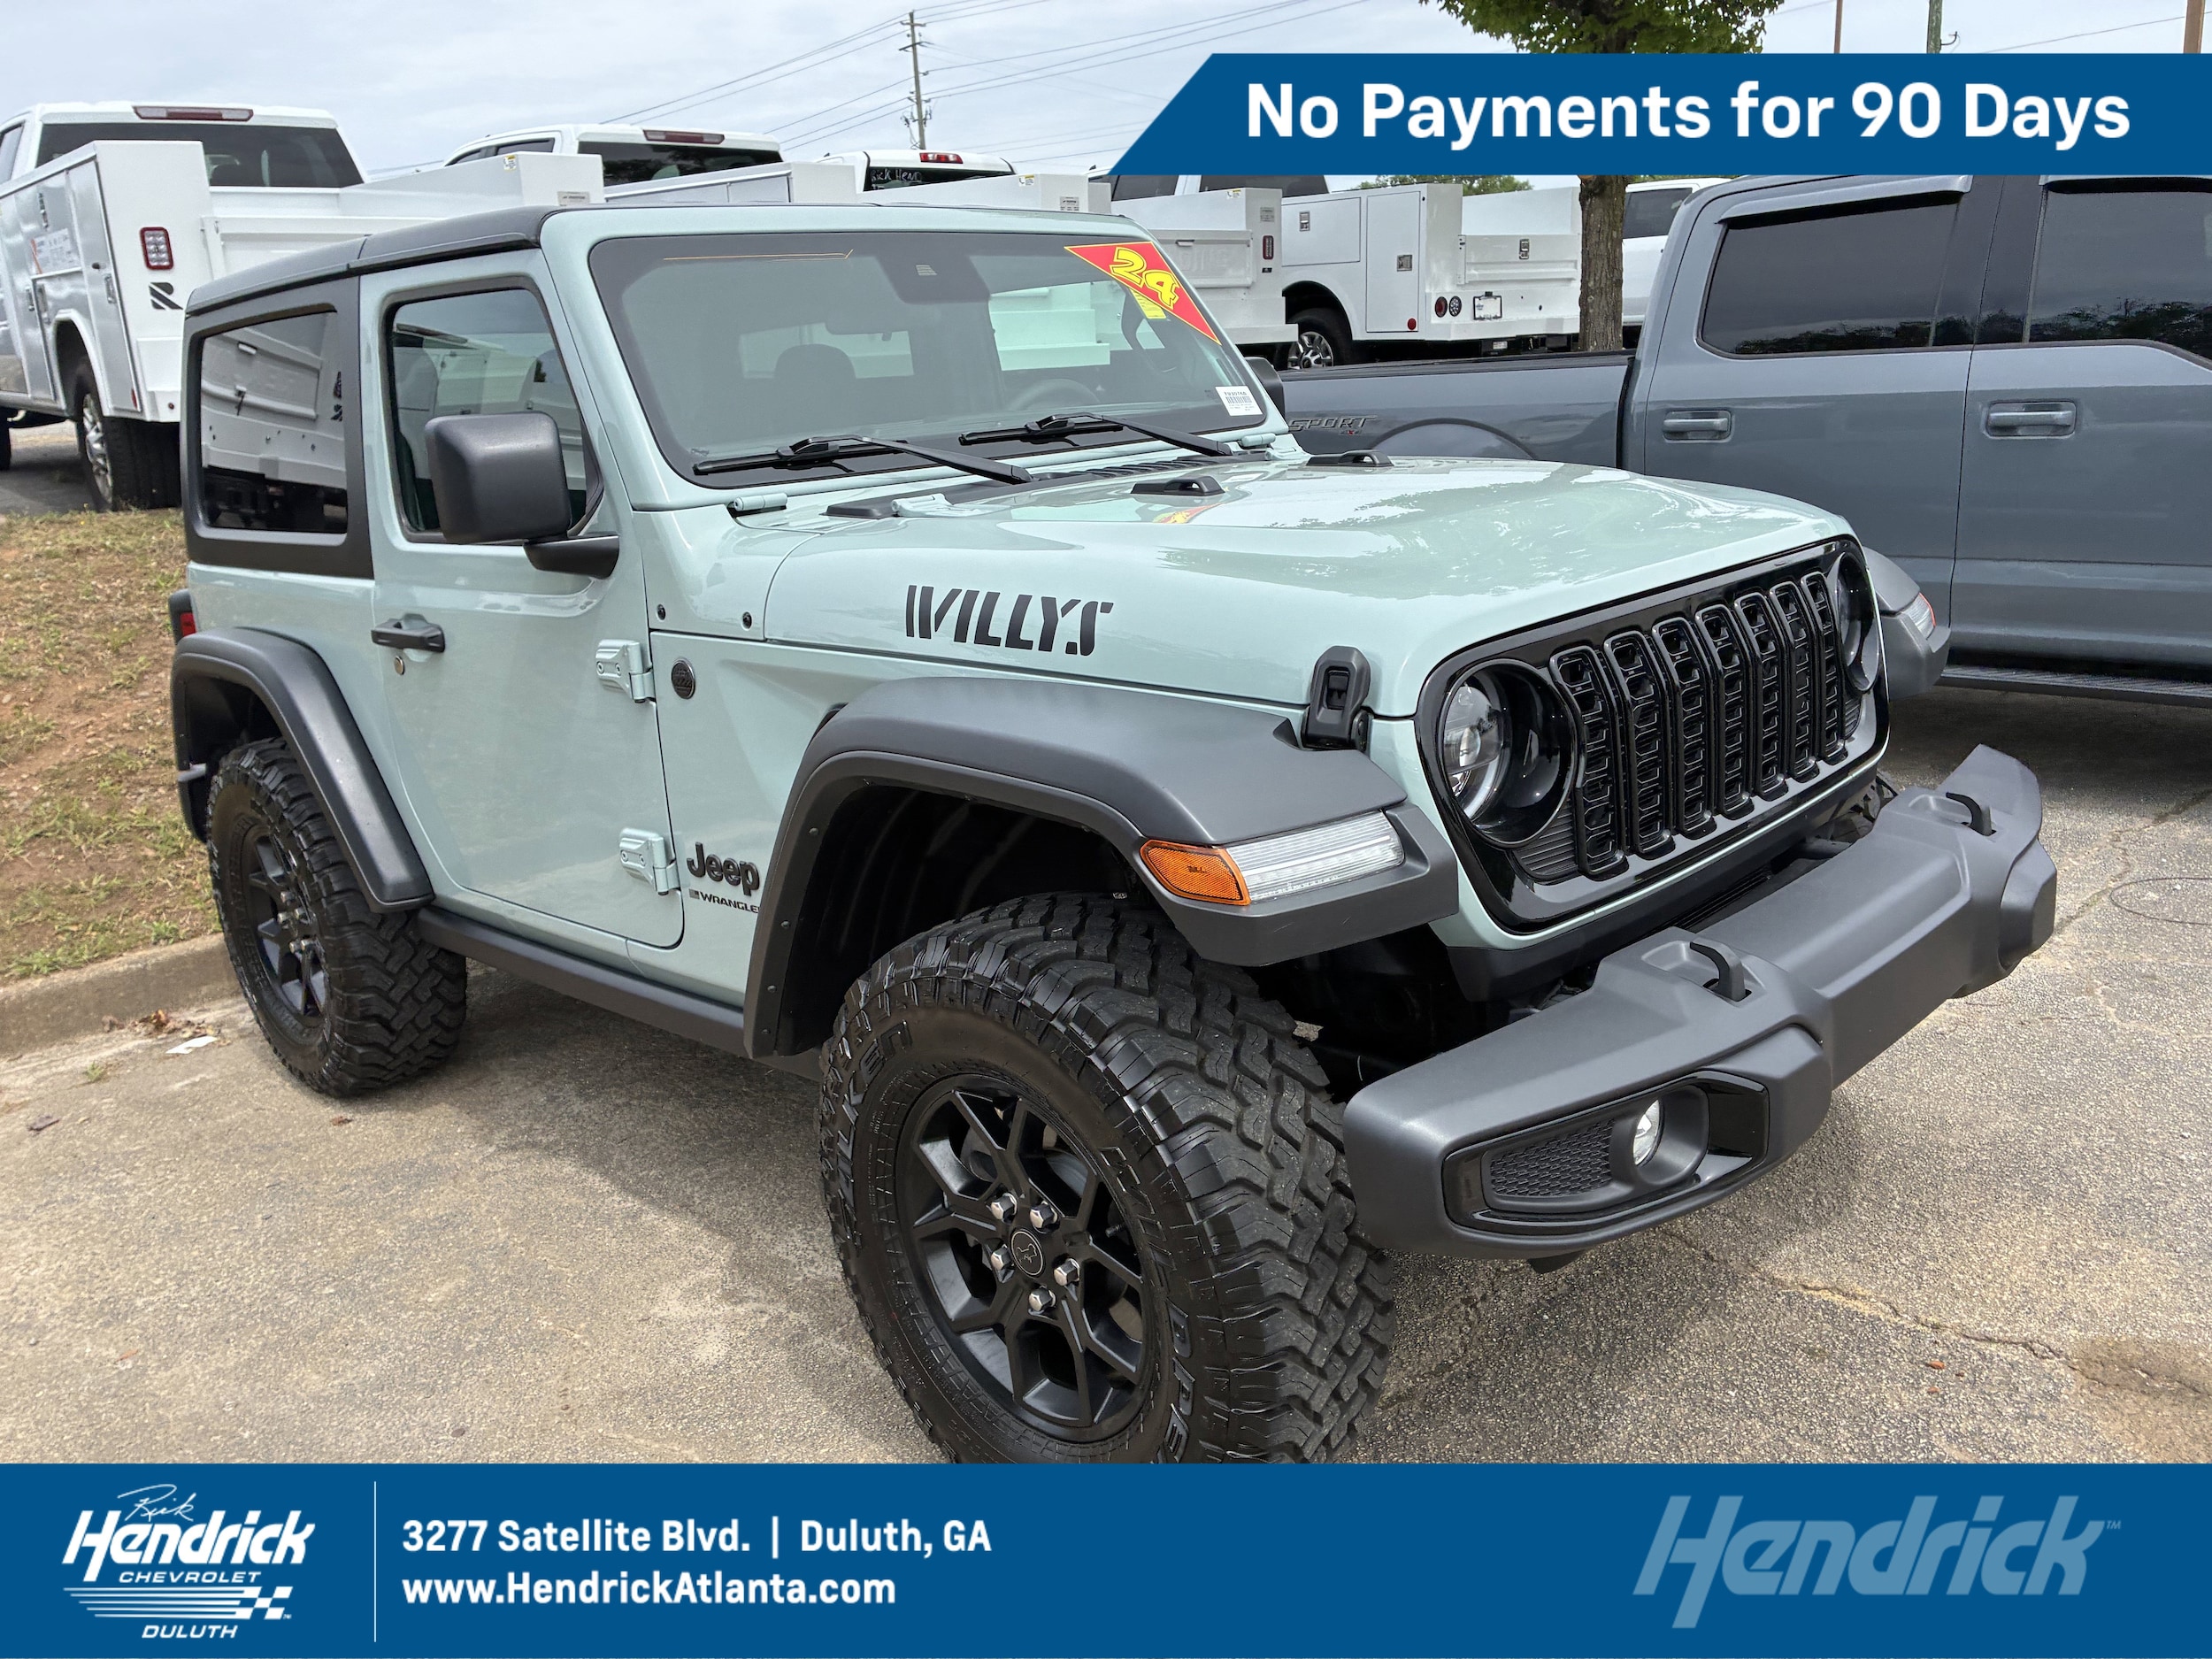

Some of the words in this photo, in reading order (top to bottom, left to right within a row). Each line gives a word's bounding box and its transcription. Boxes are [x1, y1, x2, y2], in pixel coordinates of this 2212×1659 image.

[1110, 246, 1180, 311] 24
[1287, 414, 1379, 433] SPORT
[905, 584, 1115, 657] WILLYS
[686, 841, 761, 897] Jeep
[699, 890, 761, 914] WRANGLE
